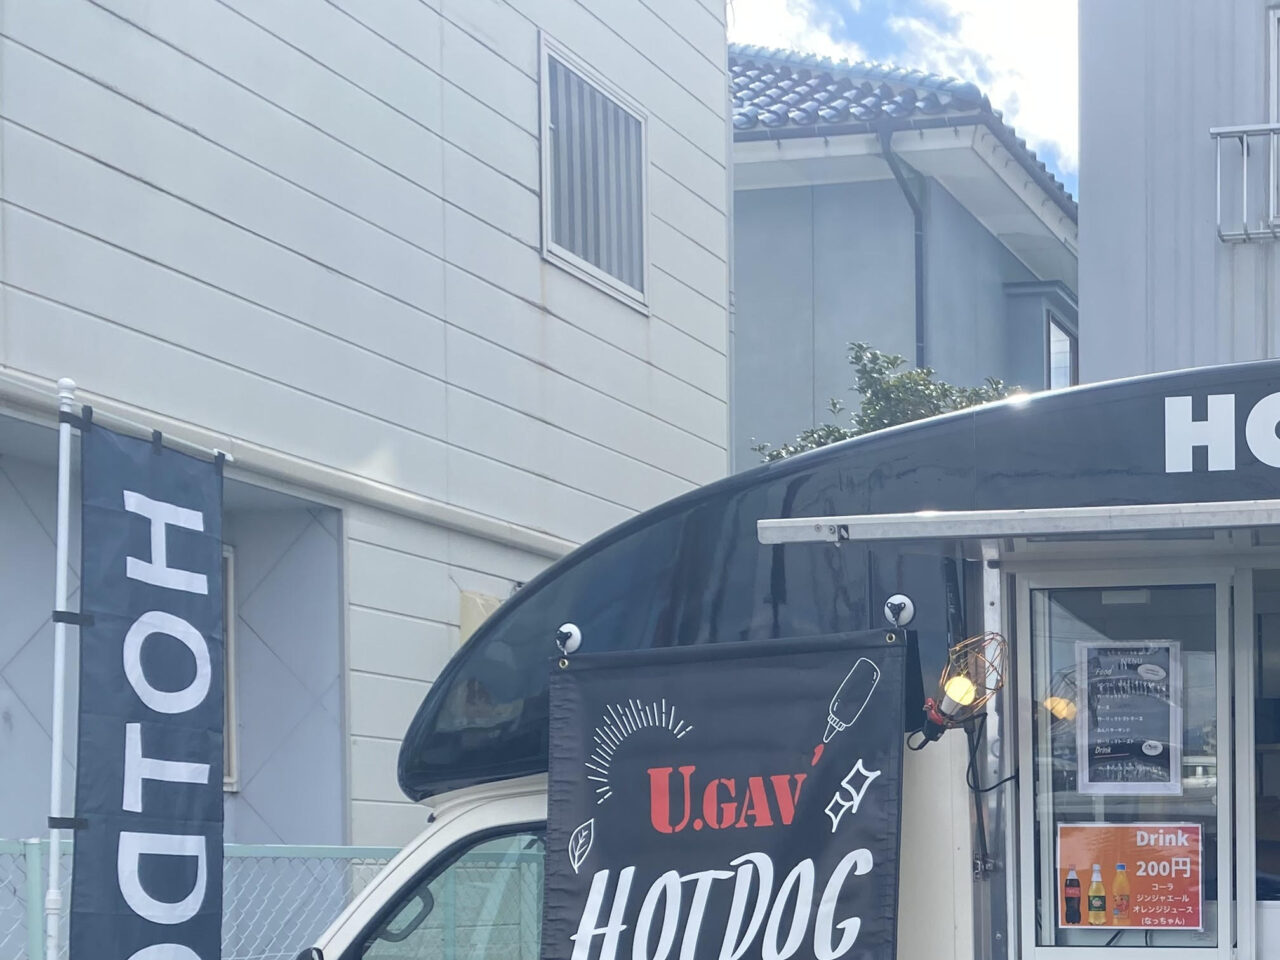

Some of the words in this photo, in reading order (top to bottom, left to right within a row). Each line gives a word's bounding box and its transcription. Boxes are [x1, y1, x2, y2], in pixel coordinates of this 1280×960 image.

[1136, 829, 1190, 847] Drink
[1135, 857, 1191, 878] 200円
[1151, 883, 1174, 891] コーラ
[1136, 894, 1190, 903] ジンジャエール
[1132, 905, 1193, 914] オレンジジュース
